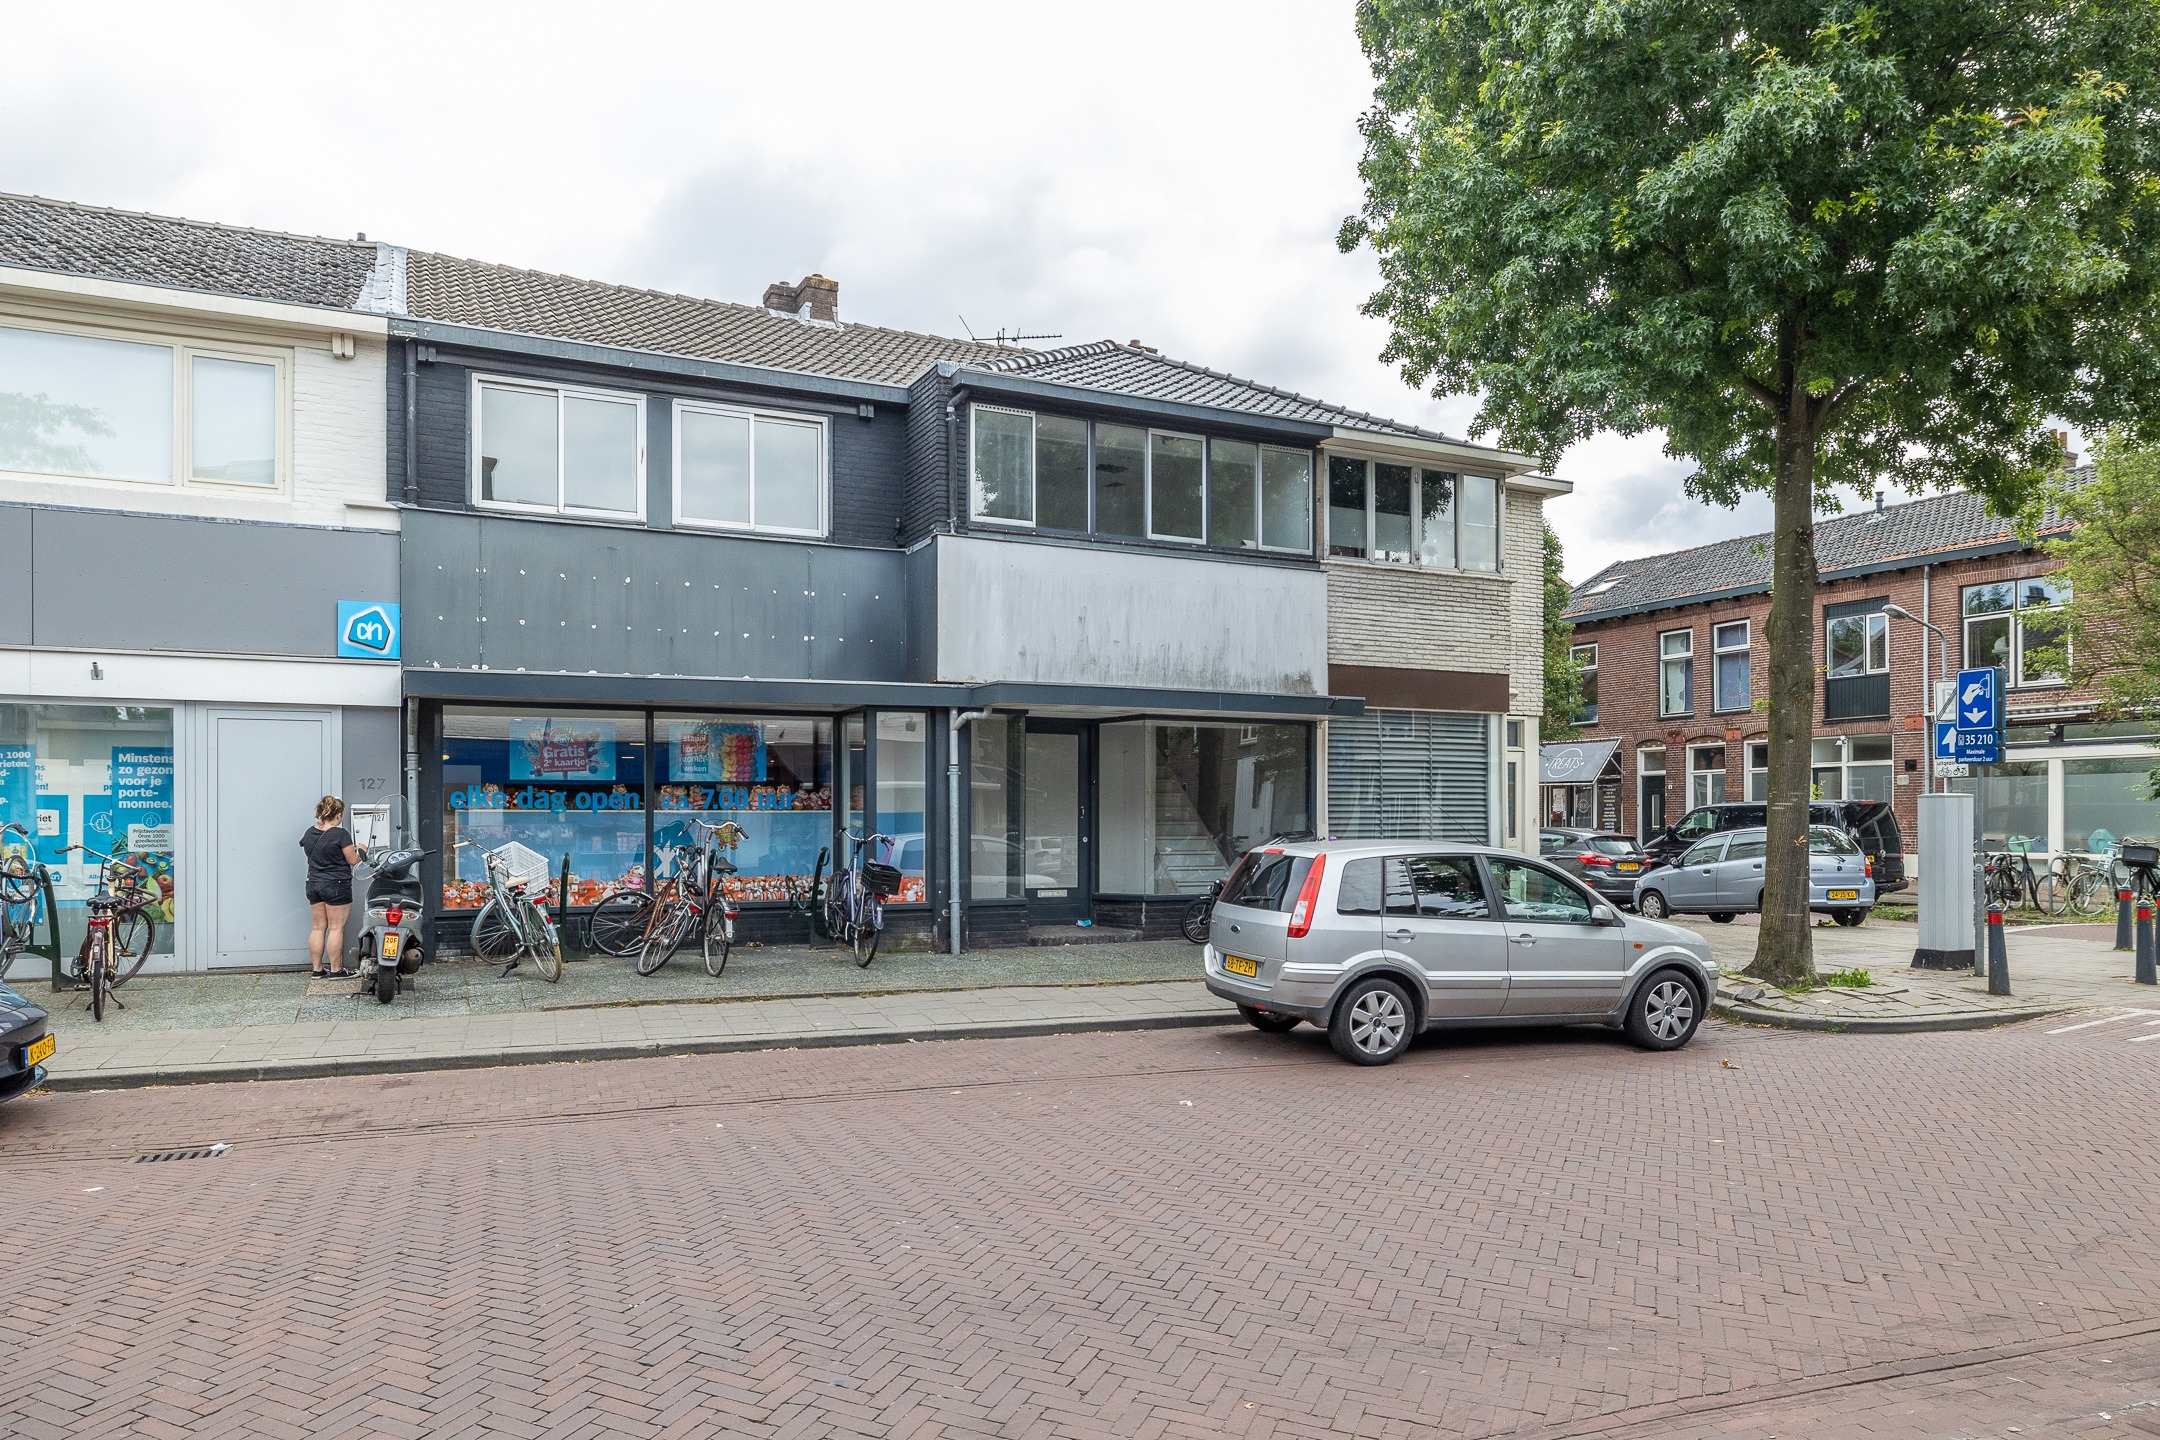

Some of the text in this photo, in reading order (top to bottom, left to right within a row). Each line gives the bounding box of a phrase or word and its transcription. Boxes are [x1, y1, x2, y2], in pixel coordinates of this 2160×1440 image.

[1965, 733, 1993, 745] 35 210
[6, 751, 31, 759] 1000
[542, 745, 585, 759] Gratis
[118, 753, 174, 764] Minstens
[554, 757, 586, 768] kaartje
[1548, 757, 1583, 770] TREATS
[118, 766, 133, 775] zo
[118, 776, 162, 788] voor je
[359, 776, 386, 790] 127
[118, 788, 159, 799] porte-
[118, 800, 172, 809] monnee.
[450, 785, 797, 815] elke dag open v.a. 7.00 uur
[374, 813, 386, 822] 127
